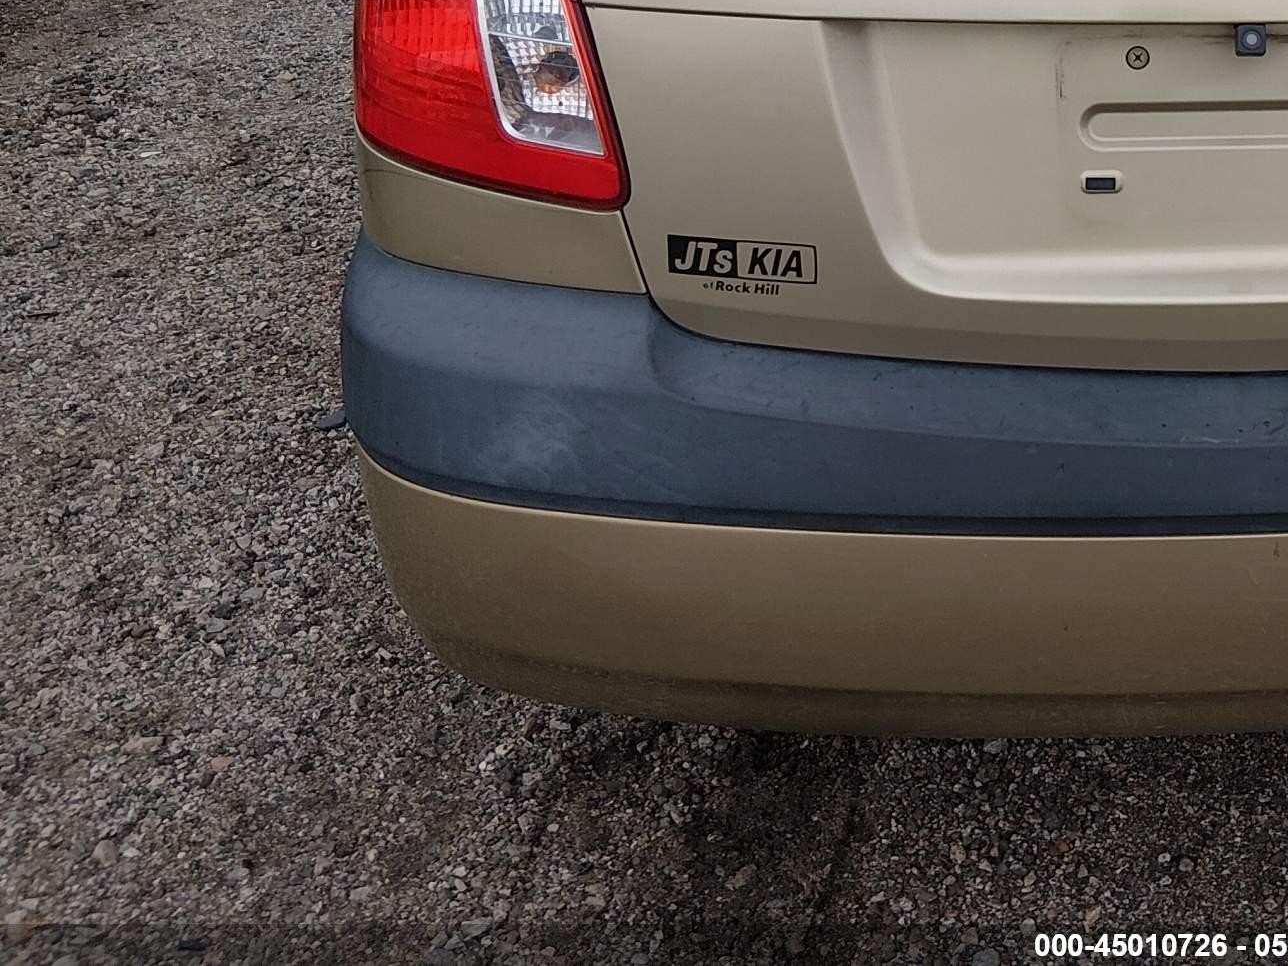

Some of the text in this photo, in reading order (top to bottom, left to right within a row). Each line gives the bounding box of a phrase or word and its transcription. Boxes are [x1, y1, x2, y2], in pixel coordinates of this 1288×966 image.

[747, 247, 804, 279] KIA
[715, 280, 751, 294] Rock
[753, 284, 780, 296] Hill
